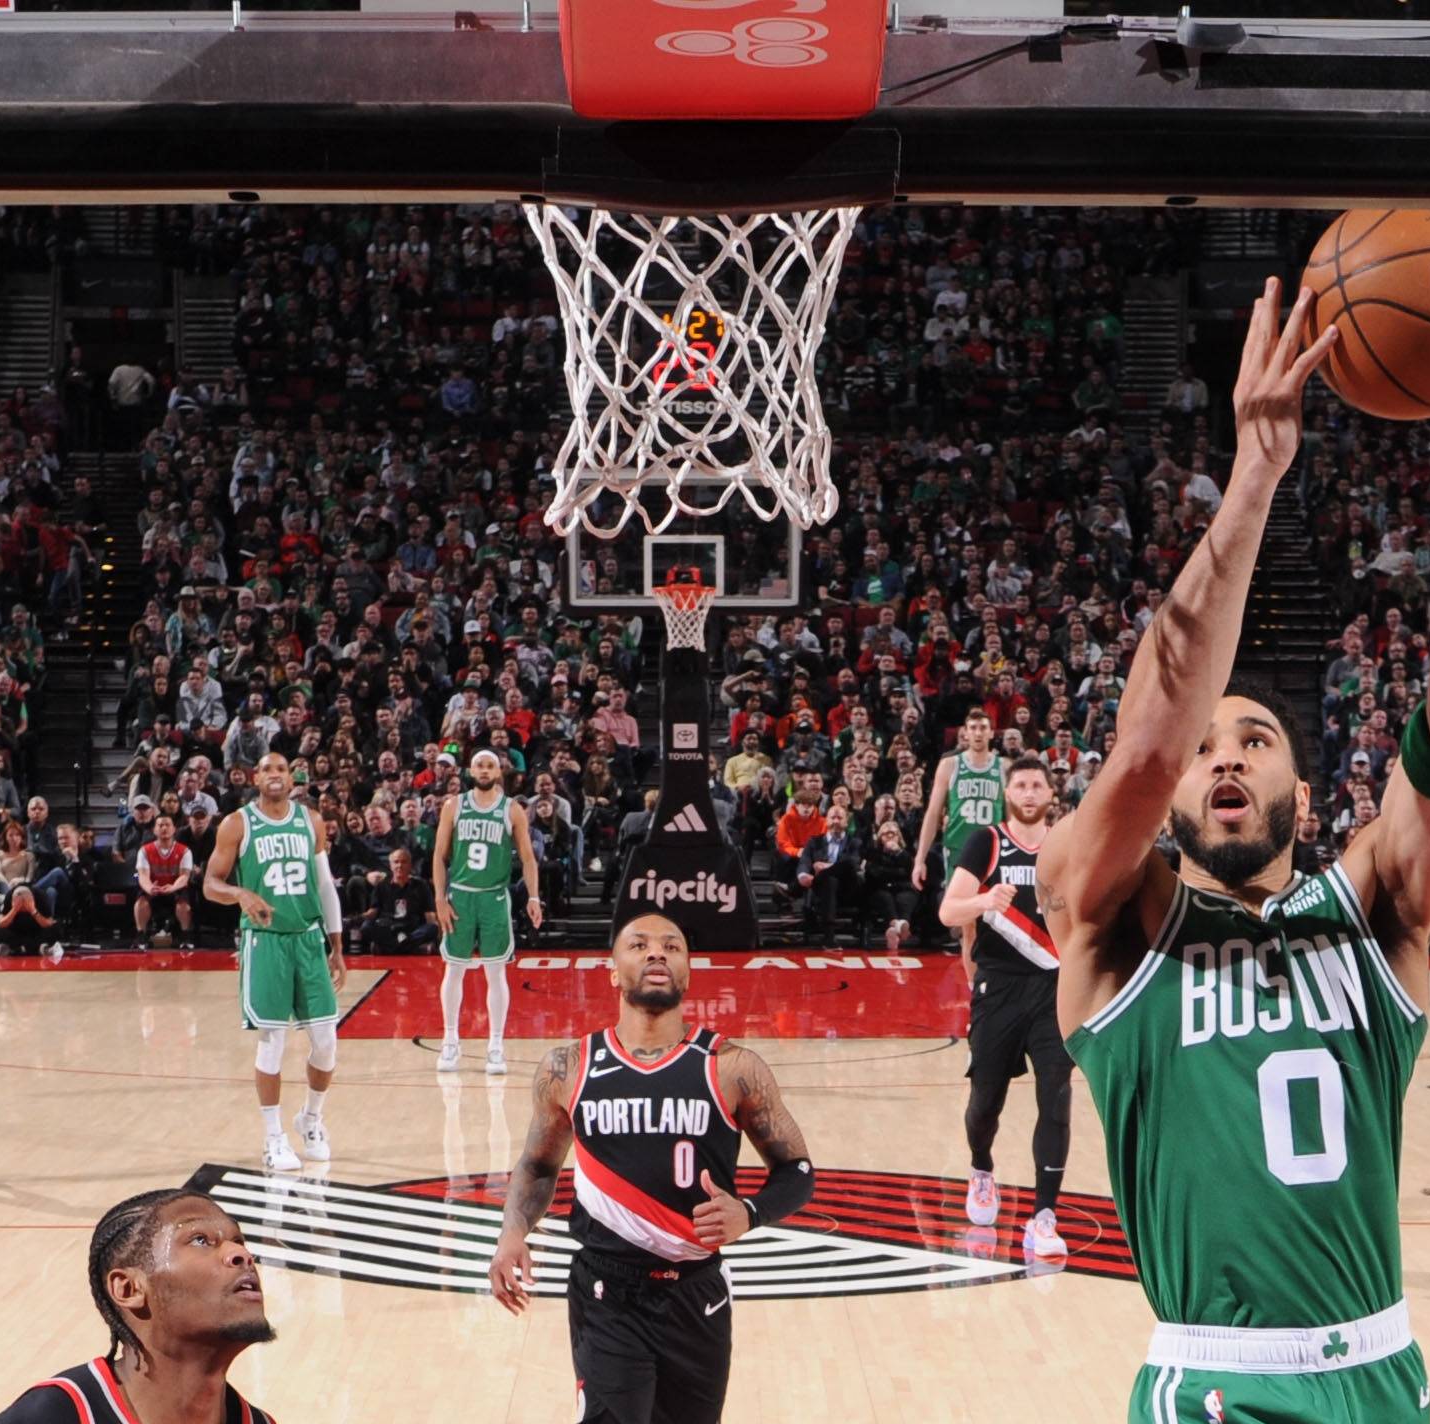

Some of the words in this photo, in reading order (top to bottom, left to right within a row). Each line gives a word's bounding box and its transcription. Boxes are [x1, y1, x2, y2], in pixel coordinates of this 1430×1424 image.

[668, 752, 704, 761] TOYOTA
[957, 778, 999, 800] BOSTON
[960, 800, 993, 825] 40
[458, 819, 504, 844] BOSTON
[254, 833, 310, 864] BOSTON
[467, 843, 489, 871] 9
[263, 862, 307, 896] 42
[629, 869, 737, 913] ripcity
[594, 1049, 607, 1062] 6
[580, 1098, 711, 1137] PORTLAND
[1257, 1048, 1348, 1186] 0
[673, 1140, 694, 1189] 0
